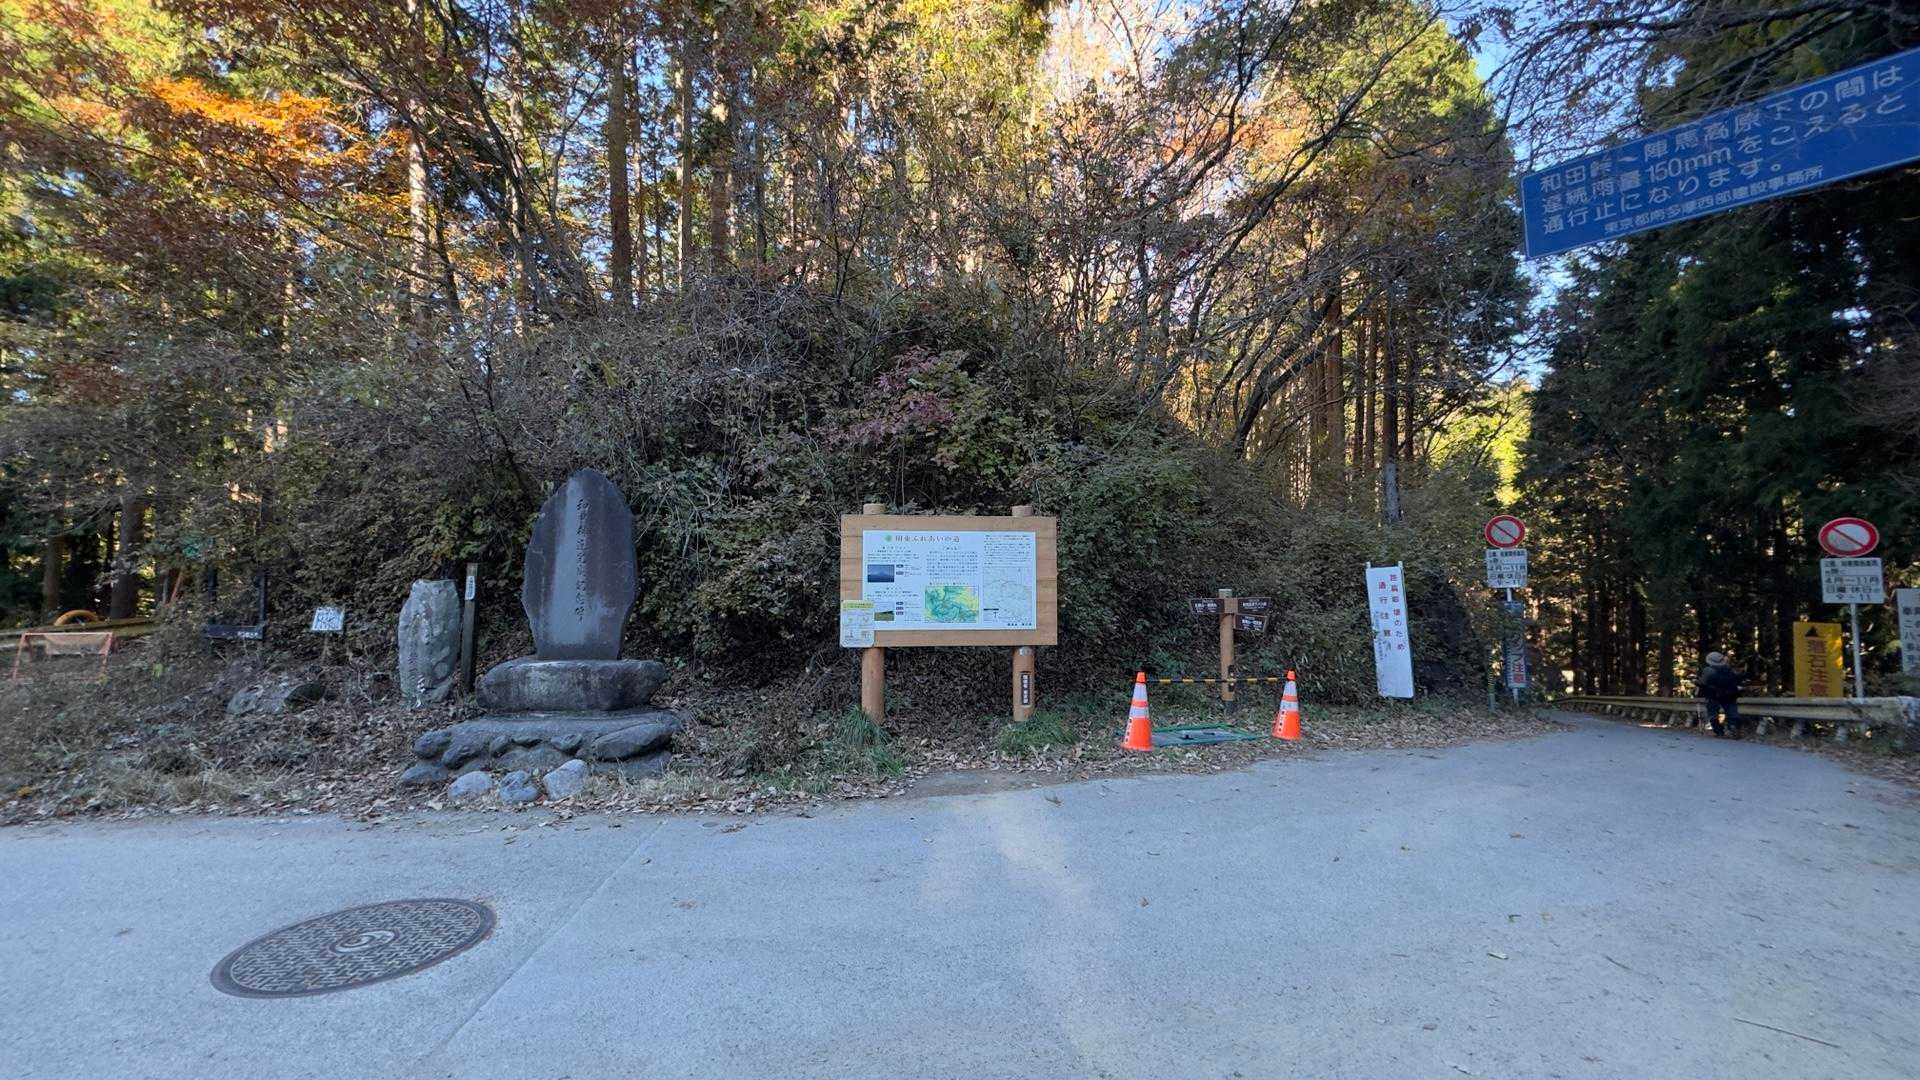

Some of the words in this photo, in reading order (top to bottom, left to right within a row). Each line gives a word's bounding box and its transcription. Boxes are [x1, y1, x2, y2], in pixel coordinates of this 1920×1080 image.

[1543, 157, 1782, 235] 通行止になります。
[1604, 164, 1824, 236] 東京都南多摩西部建設事務所
